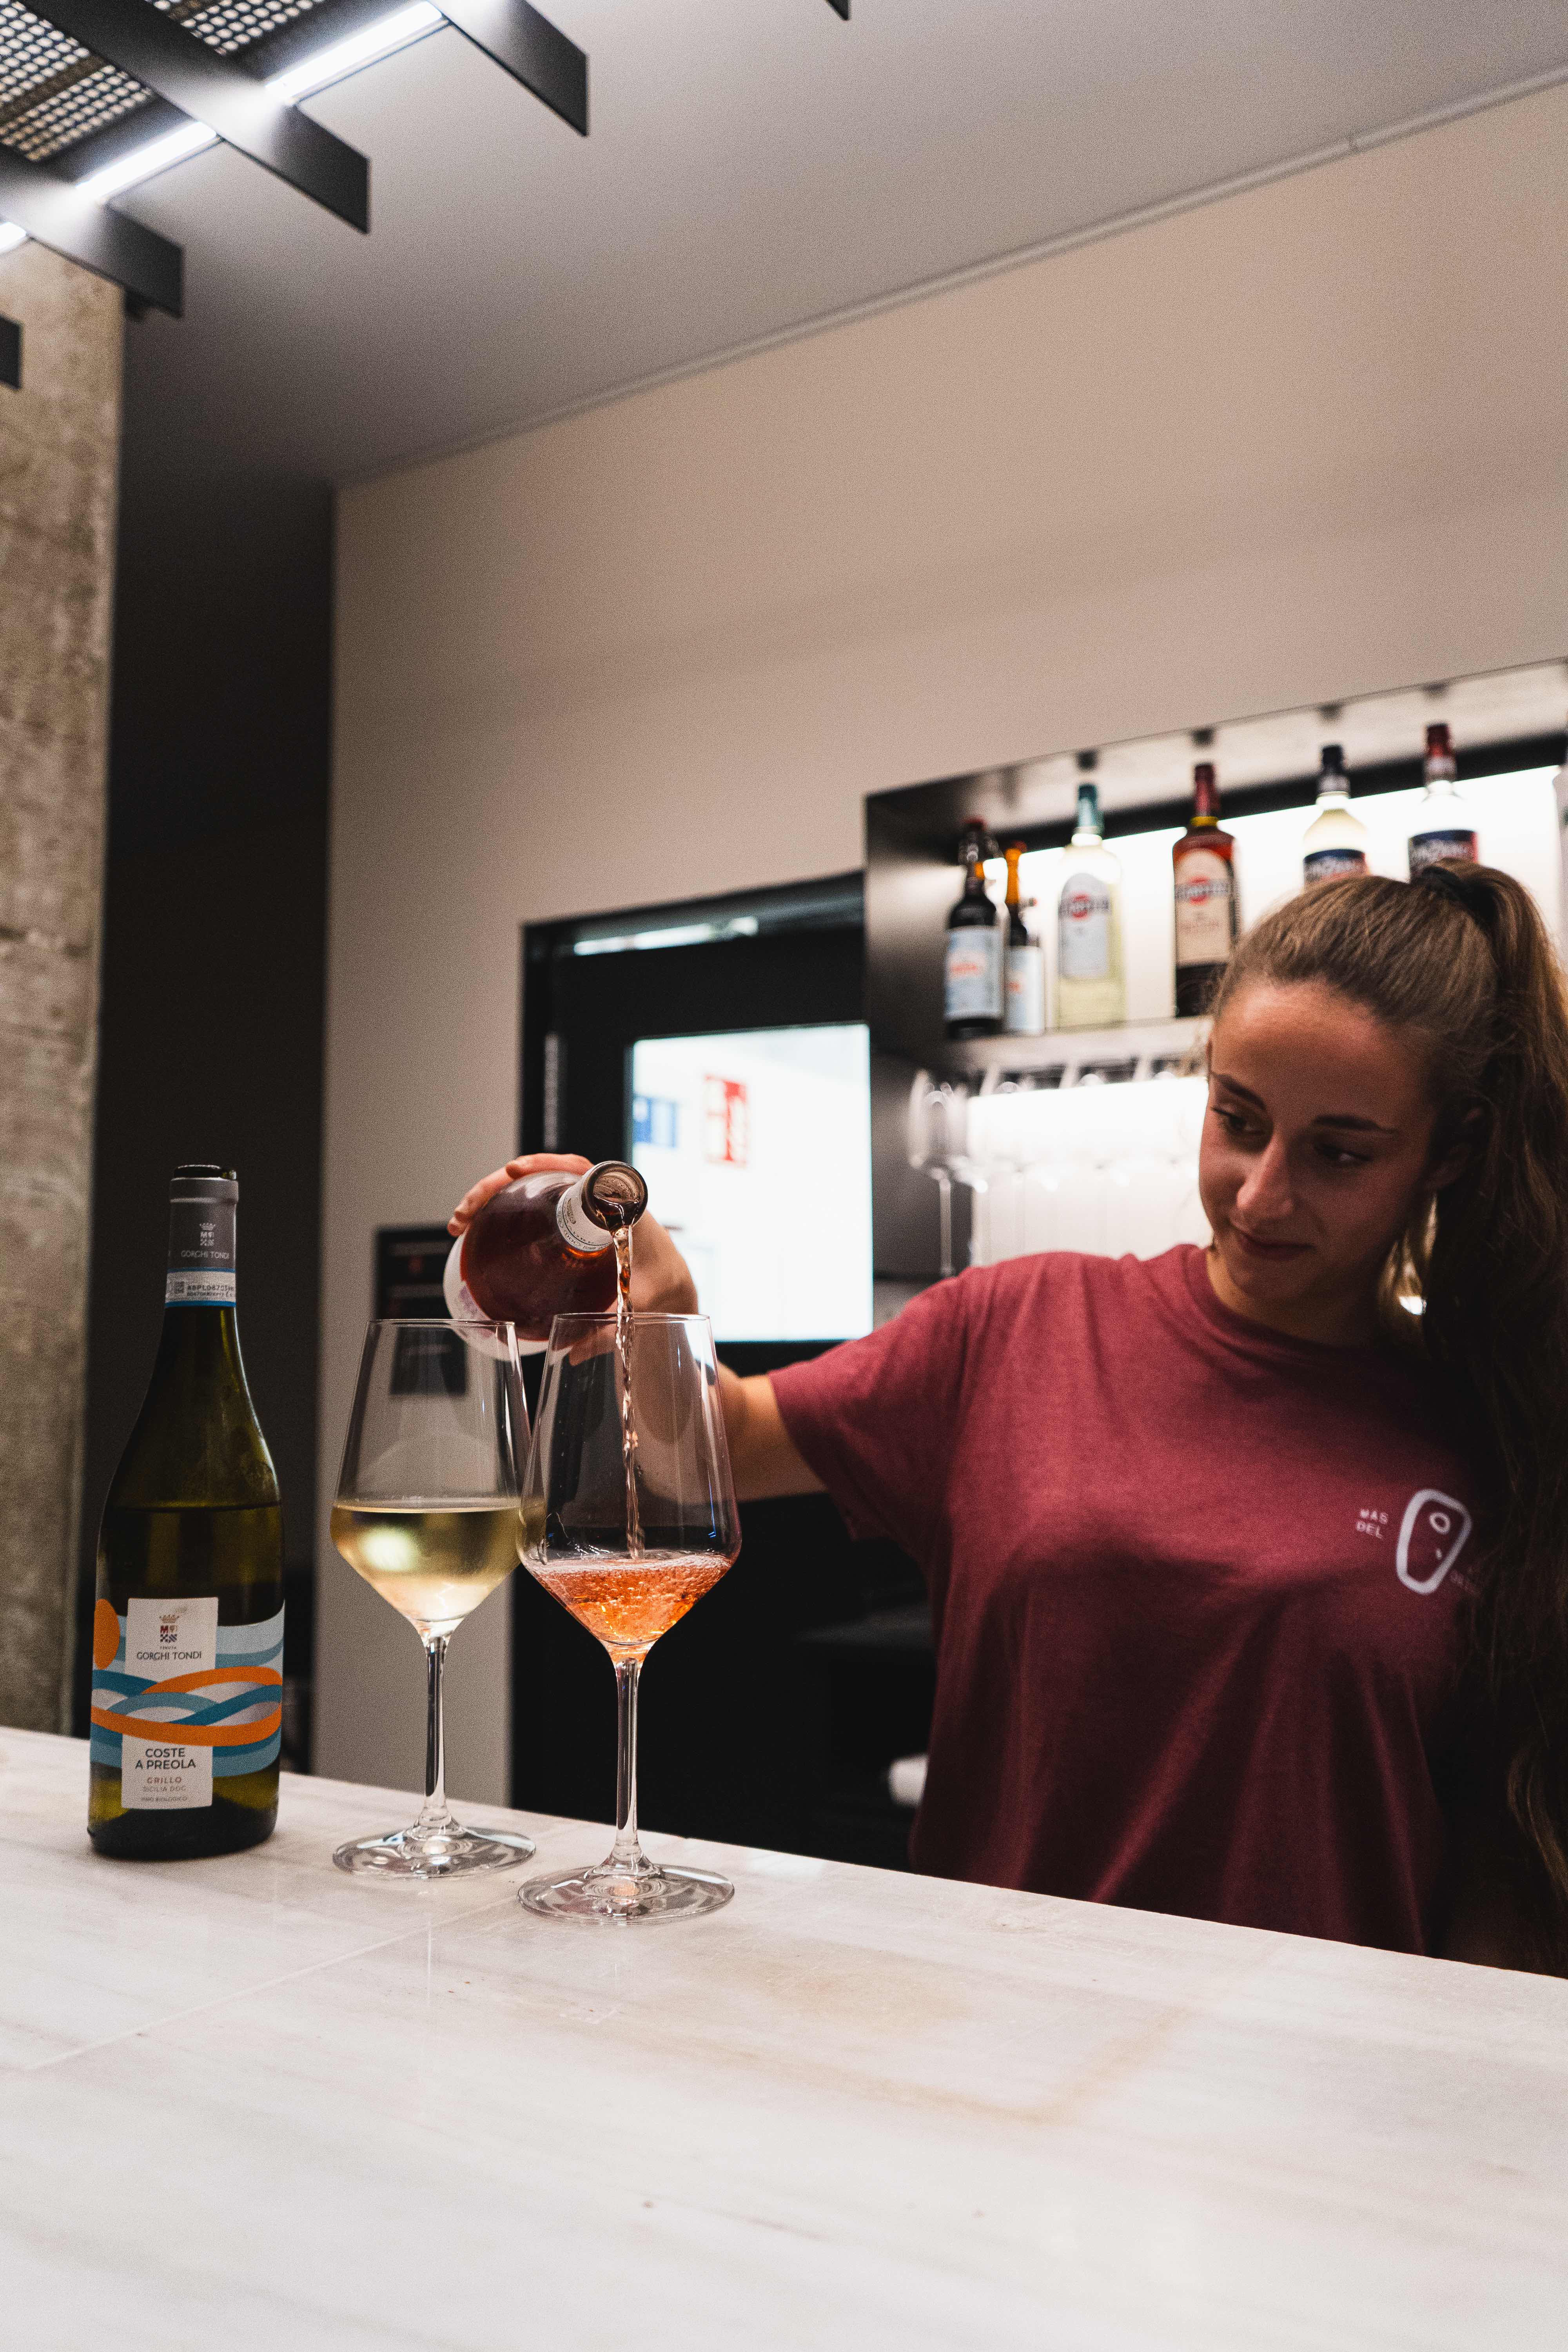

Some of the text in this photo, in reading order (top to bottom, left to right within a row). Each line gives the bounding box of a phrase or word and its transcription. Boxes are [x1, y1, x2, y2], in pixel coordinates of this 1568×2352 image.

[136, 1651, 201, 1661] GORGHI TONDI
[145, 1748, 185, 1758] COSTE
[135, 1759, 196, 1769] A PREOLA
